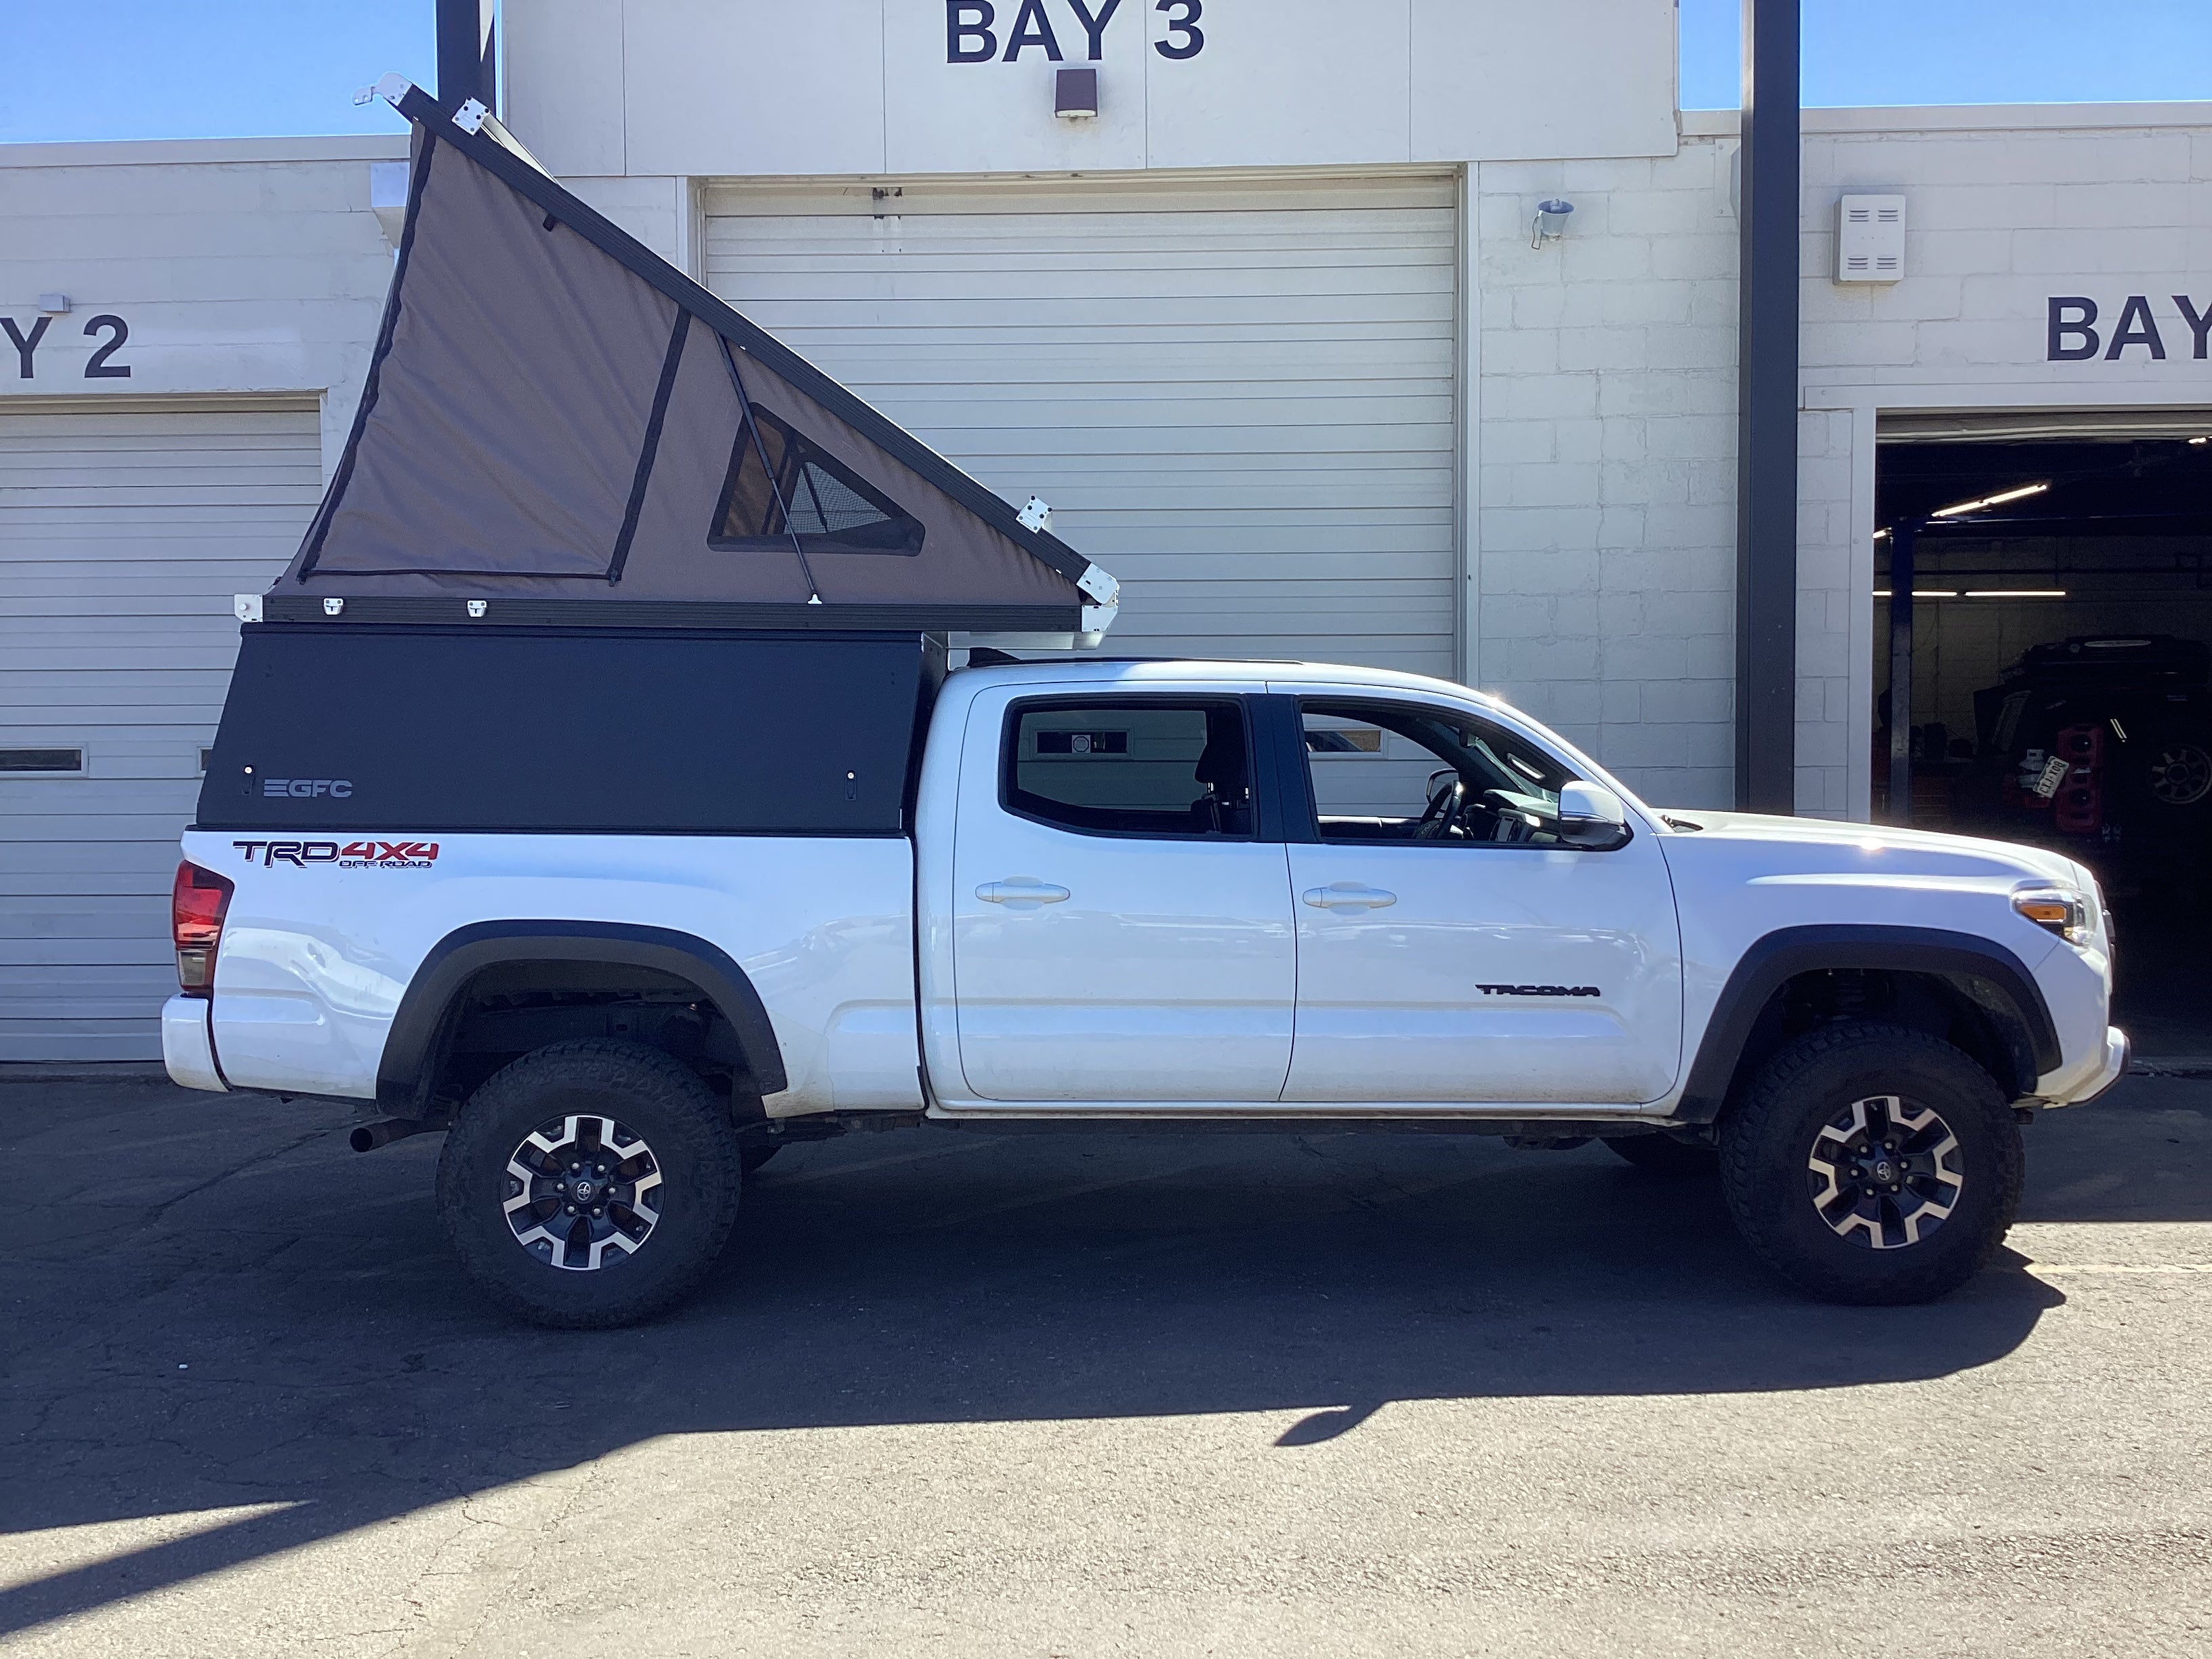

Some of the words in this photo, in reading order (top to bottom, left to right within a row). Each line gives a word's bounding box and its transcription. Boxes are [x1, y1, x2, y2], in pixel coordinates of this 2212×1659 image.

[946, 0, 1122, 63] BAY
[1153, 0, 1204, 60] 3
[83, 314, 131, 379] 2
[2047, 295, 2212, 361] BAY
[232, 840, 340, 868] TRD
[338, 860, 377, 869] OFF
[379, 860, 433, 869] ROAD
[1474, 983, 1601, 997] TACOMA
